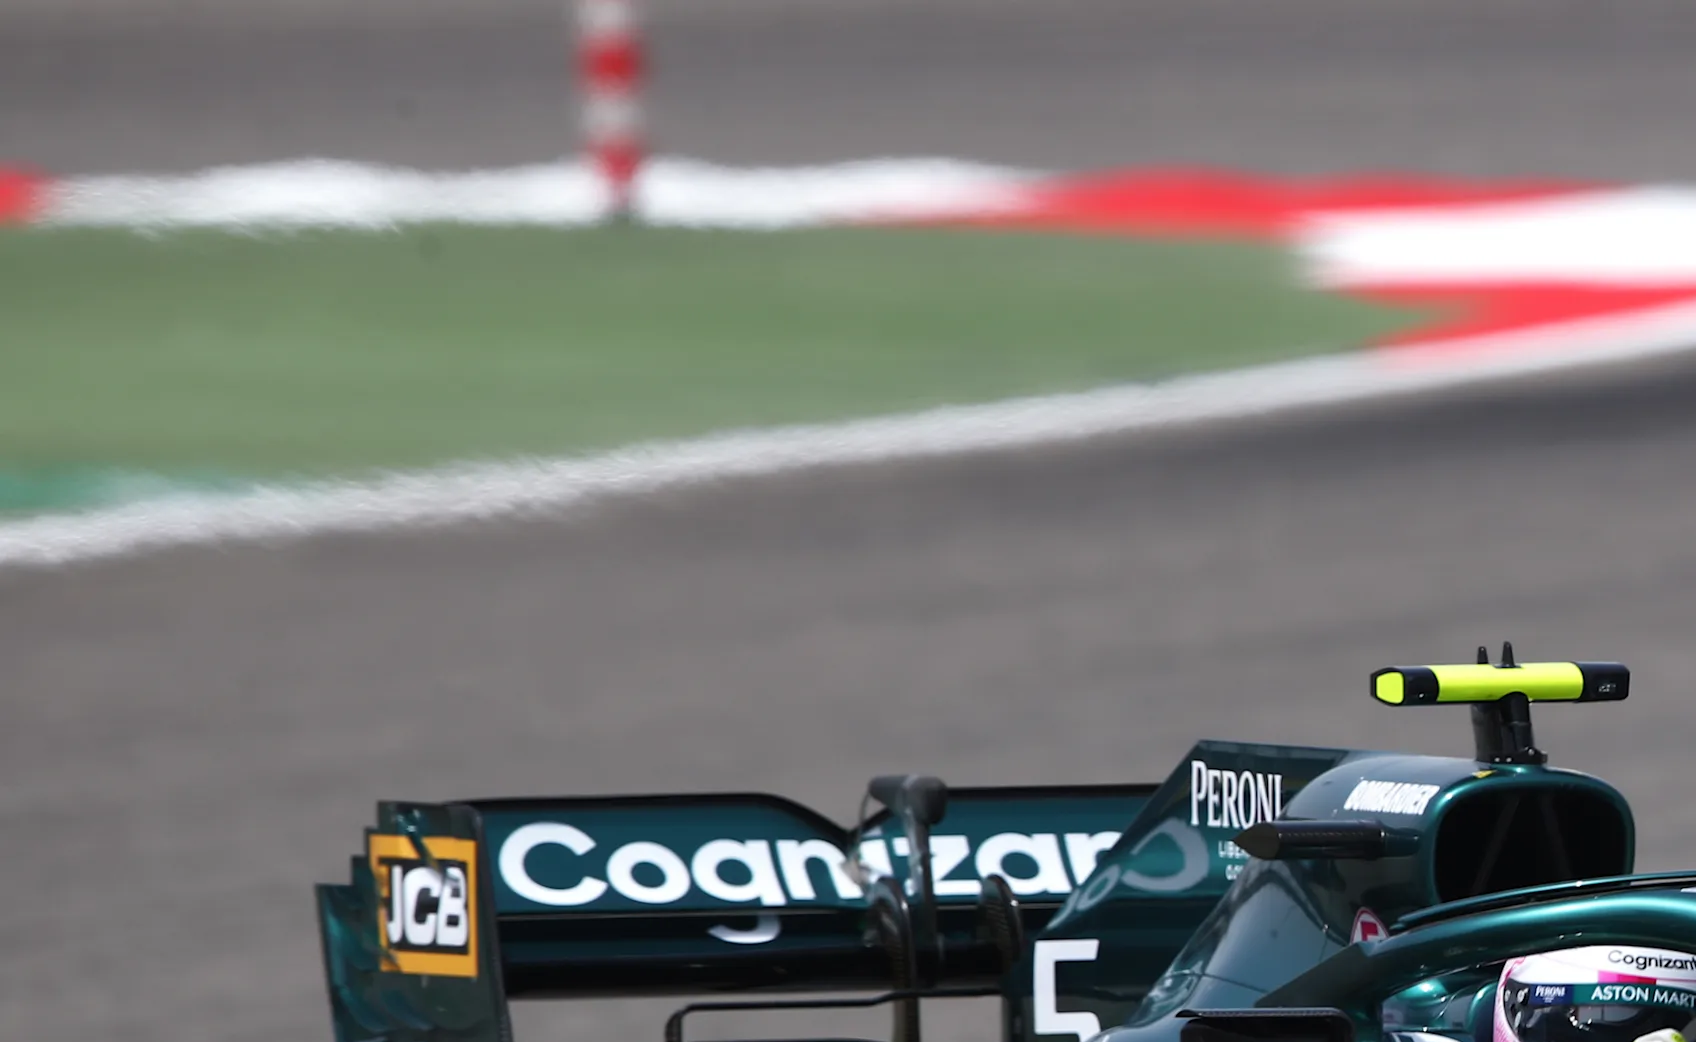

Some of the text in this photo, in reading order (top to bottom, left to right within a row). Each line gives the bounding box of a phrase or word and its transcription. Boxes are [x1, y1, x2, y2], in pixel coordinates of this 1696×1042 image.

[1190, 760, 1283, 829] PERONI
[387, 864, 469, 946] JCB
[497, 820, 1124, 944] Cognizan
[1590, 984, 1650, 1003] ASTON
